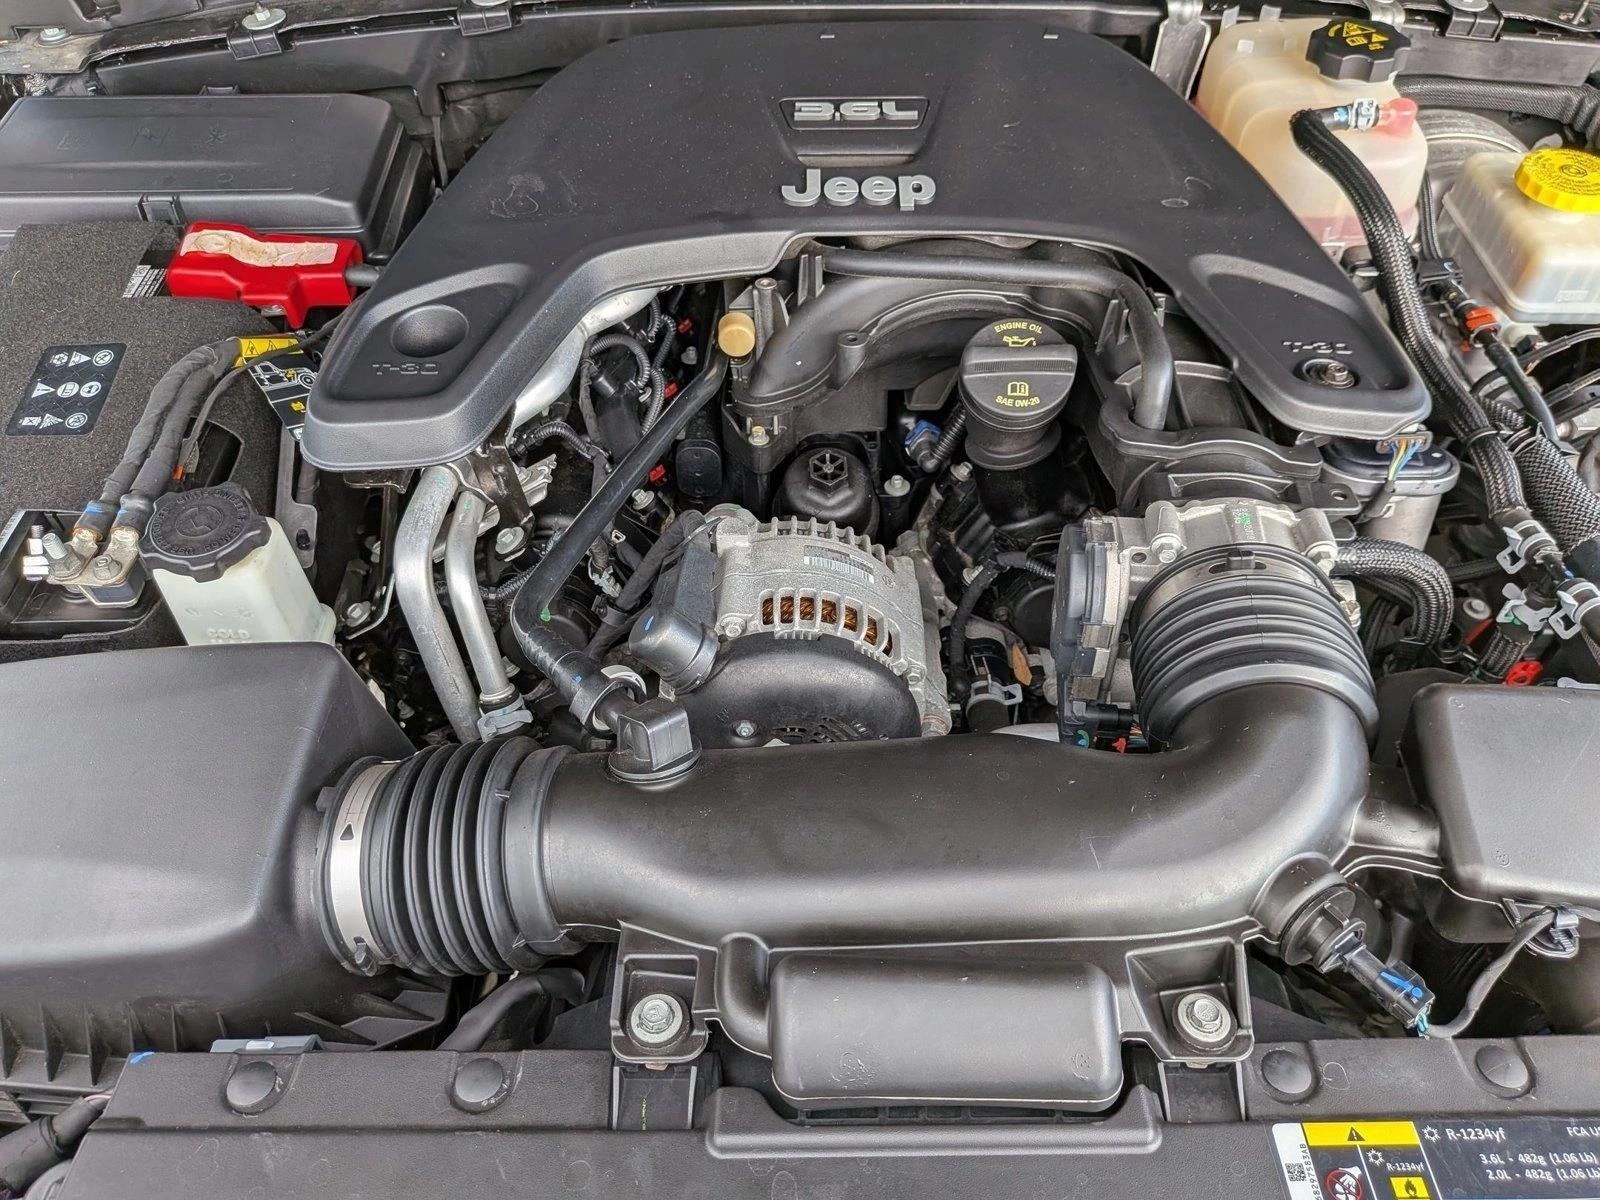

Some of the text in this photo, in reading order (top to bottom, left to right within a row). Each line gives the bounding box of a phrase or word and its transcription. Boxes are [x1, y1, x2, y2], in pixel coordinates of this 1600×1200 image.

[794, 101, 918, 121] 3.6L
[781, 168, 936, 211] Jeep
[994, 322, 1043, 334] ENGINE OIL
[995, 395, 1040, 407] SAE 0W-20
[1445, 1128, 1506, 1142] R-1234yf
[1566, 1126, 1600, 1137] FCA U
[1479, 1153, 1505, 1164] 3.6L
[1518, 1153, 1547, 1166] 482g
[1549, 1152, 1578, 1165] (1.06
[1578, 1152, 1598, 1164] Lb)
[1386, 1162, 1425, 1172] R-1234yf
[1486, 1169, 1512, 1181] 2.0L
[1525, 1169, 1554, 1182] 482g
[1556, 1168, 1586, 1181] (1.06
[1586, 1168, 1600, 1179] Lb
